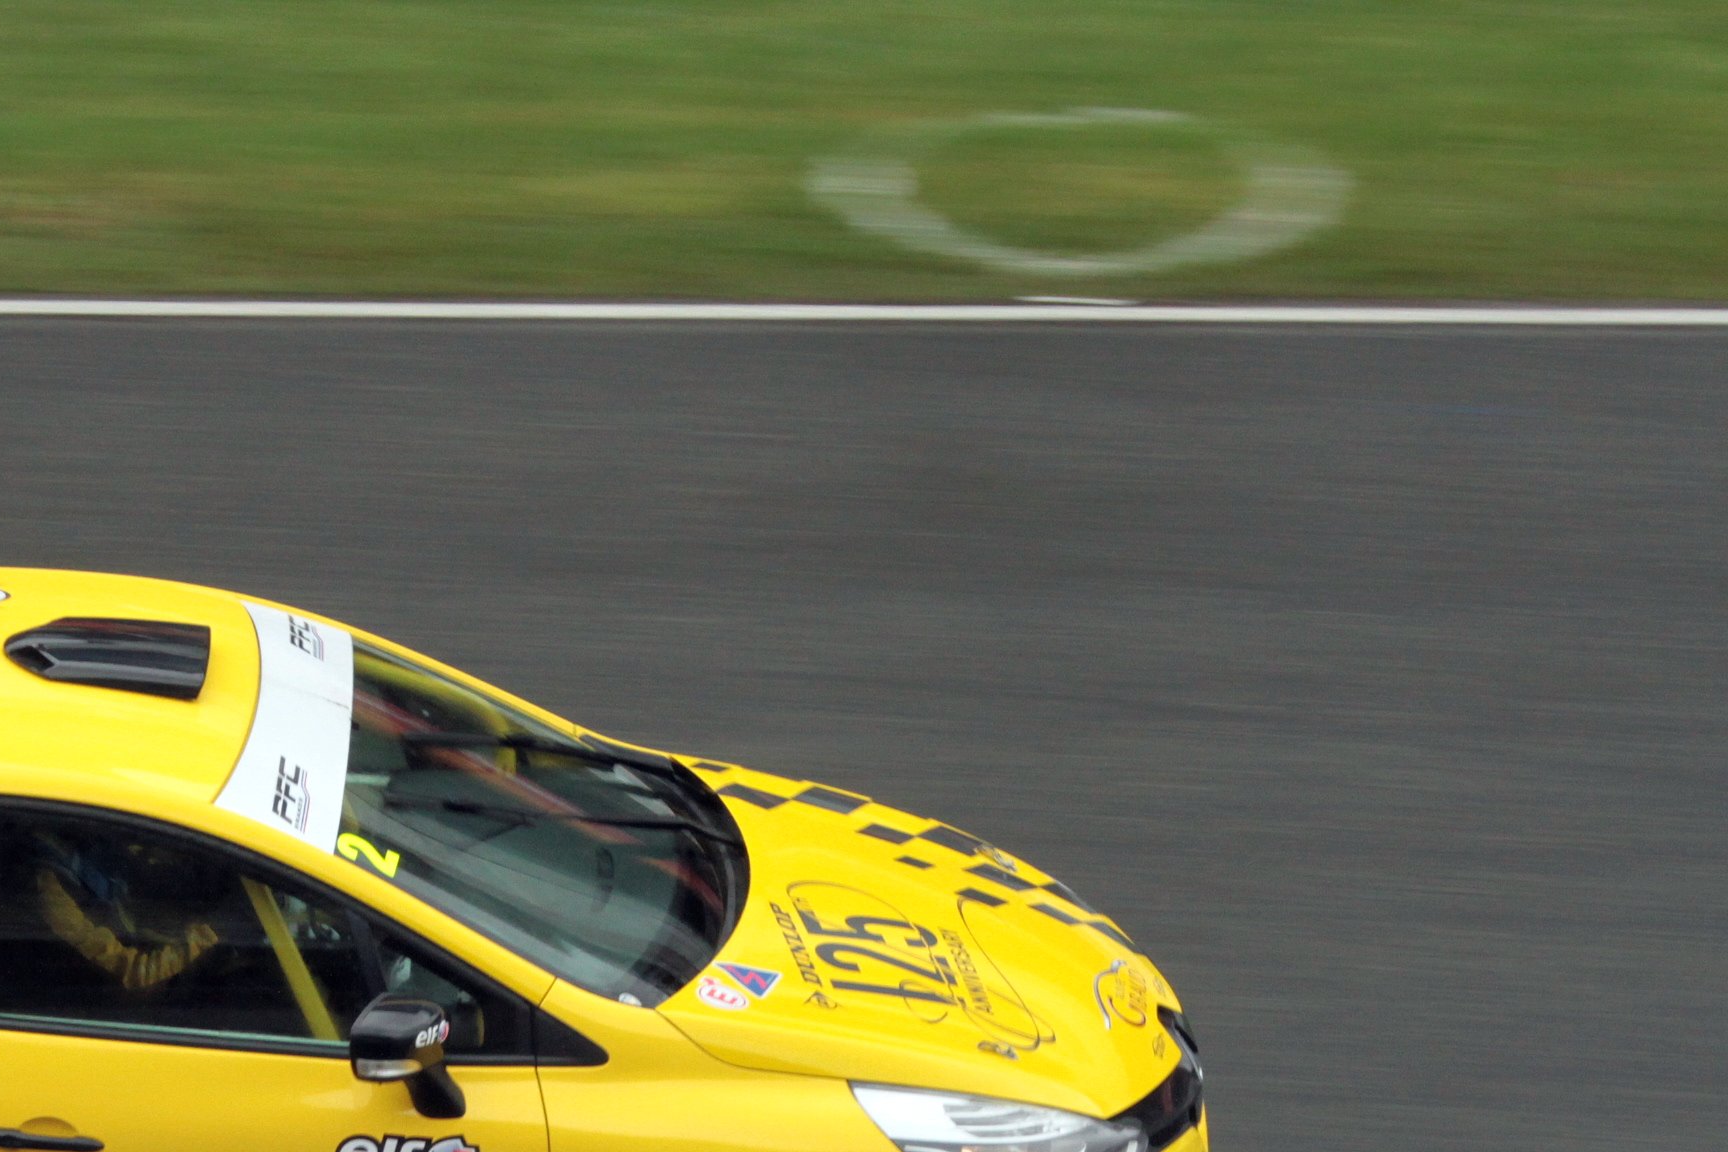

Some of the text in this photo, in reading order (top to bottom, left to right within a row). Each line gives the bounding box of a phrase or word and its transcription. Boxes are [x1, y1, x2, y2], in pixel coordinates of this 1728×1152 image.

[272, 755, 301, 825] PFC
[337, 832, 400, 878] 2
[769, 901, 822, 988] DUNLOP
[415, 1025, 439, 1049] elf
